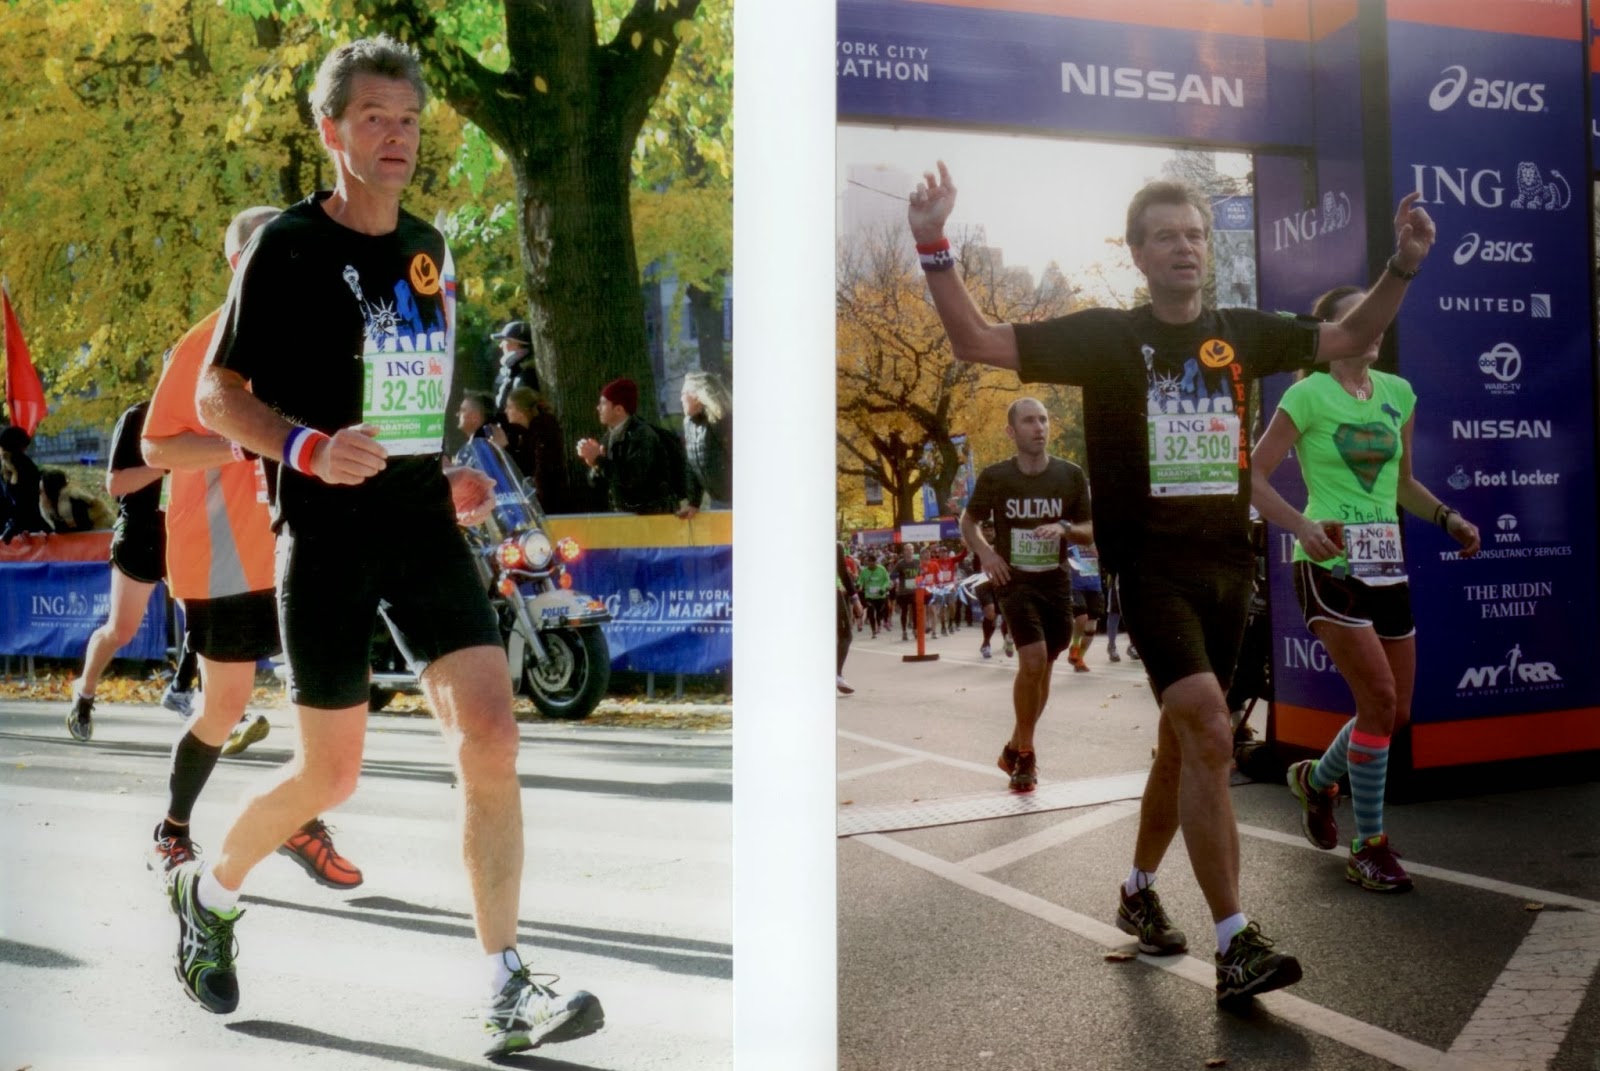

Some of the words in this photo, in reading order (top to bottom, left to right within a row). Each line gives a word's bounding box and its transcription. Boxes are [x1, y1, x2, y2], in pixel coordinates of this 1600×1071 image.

[887, 45, 929, 60] CITY
[1061, 62, 1244, 108] NISSAN
[1468, 78, 1546, 112] asics
[1411, 164, 1506, 208] ING
[1274, 208, 1318, 252] ING
[1480, 240, 1534, 263] asics
[1439, 296, 1525, 313] UNITED
[387, 360, 425, 377] ING
[1484, 382, 1522, 391] WABC-TV
[1168, 419, 1205, 433] ING
[1453, 420, 1552, 439] NISSAN
[1164, 435, 1231, 461] 32-509
[1474, 470, 1507, 486] Foot
[1512, 469, 1560, 486] Locker
[1006, 498, 1063, 519] SULTAN
[1360, 528, 1383, 539] ING
[1495, 533, 1521, 543] TATA
[1019, 540, 1055, 554] 50-787
[1440, 551, 1468, 561] TAT
[1534, 546, 1572, 557] SERVICES
[669, 590, 694, 602] NEW
[699, 589, 730, 602] YORK
[1464, 584, 1500, 601] THE
[1502, 582, 1553, 600] RUDIN
[32, 595, 65, 616] ING
[541, 606, 570, 618] POLICE
[1481, 601, 1538, 619] FAMILY
[1284, 636, 1328, 672] ING
